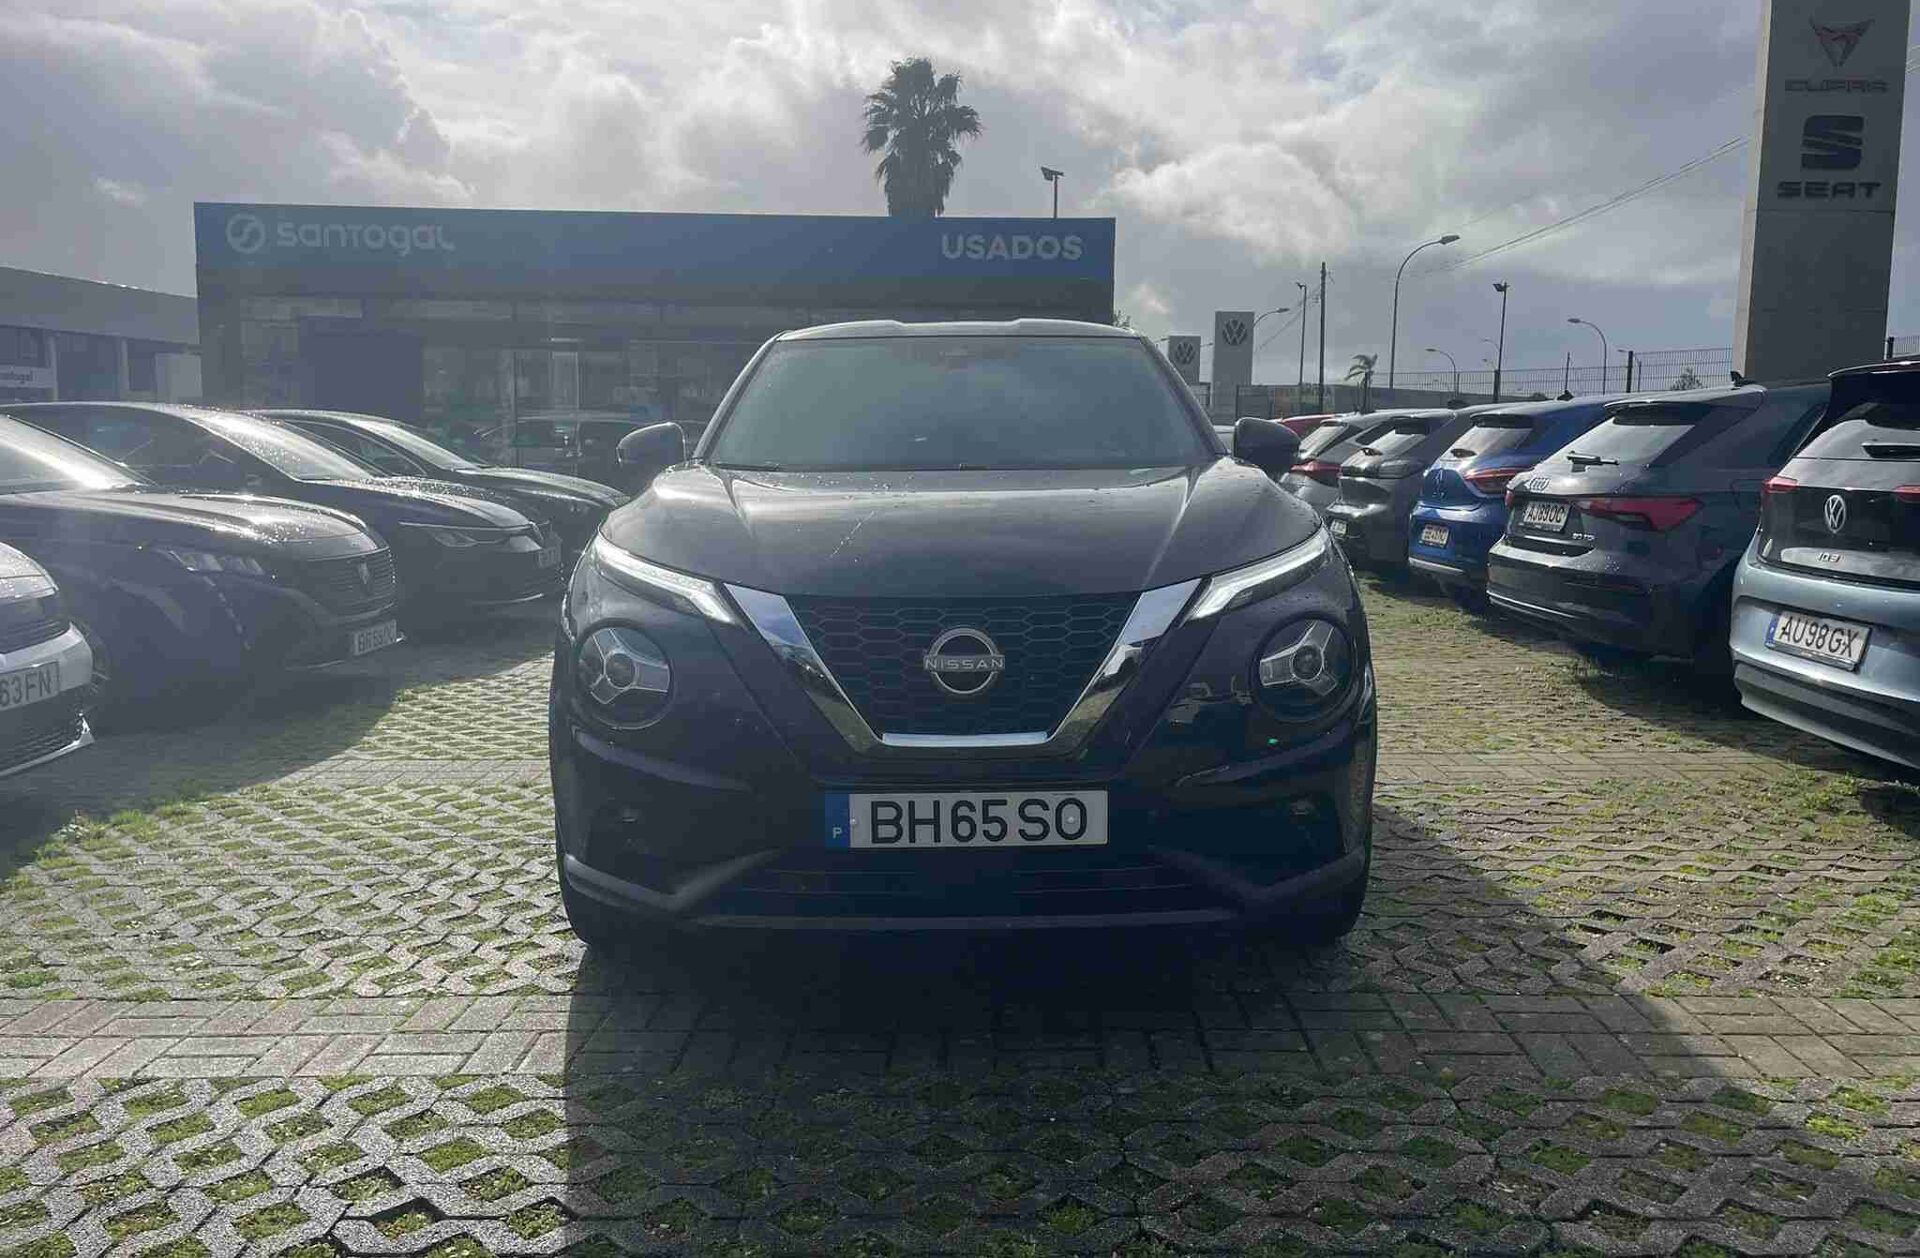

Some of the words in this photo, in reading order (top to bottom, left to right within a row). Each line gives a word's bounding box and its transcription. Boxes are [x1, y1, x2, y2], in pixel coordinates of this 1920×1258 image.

[1777, 181, 1882, 199] SEAT
[941, 233, 1083, 261] USADOS
[1779, 615, 1859, 658] AU98GX
[924, 658, 1005, 670] NISSAN
